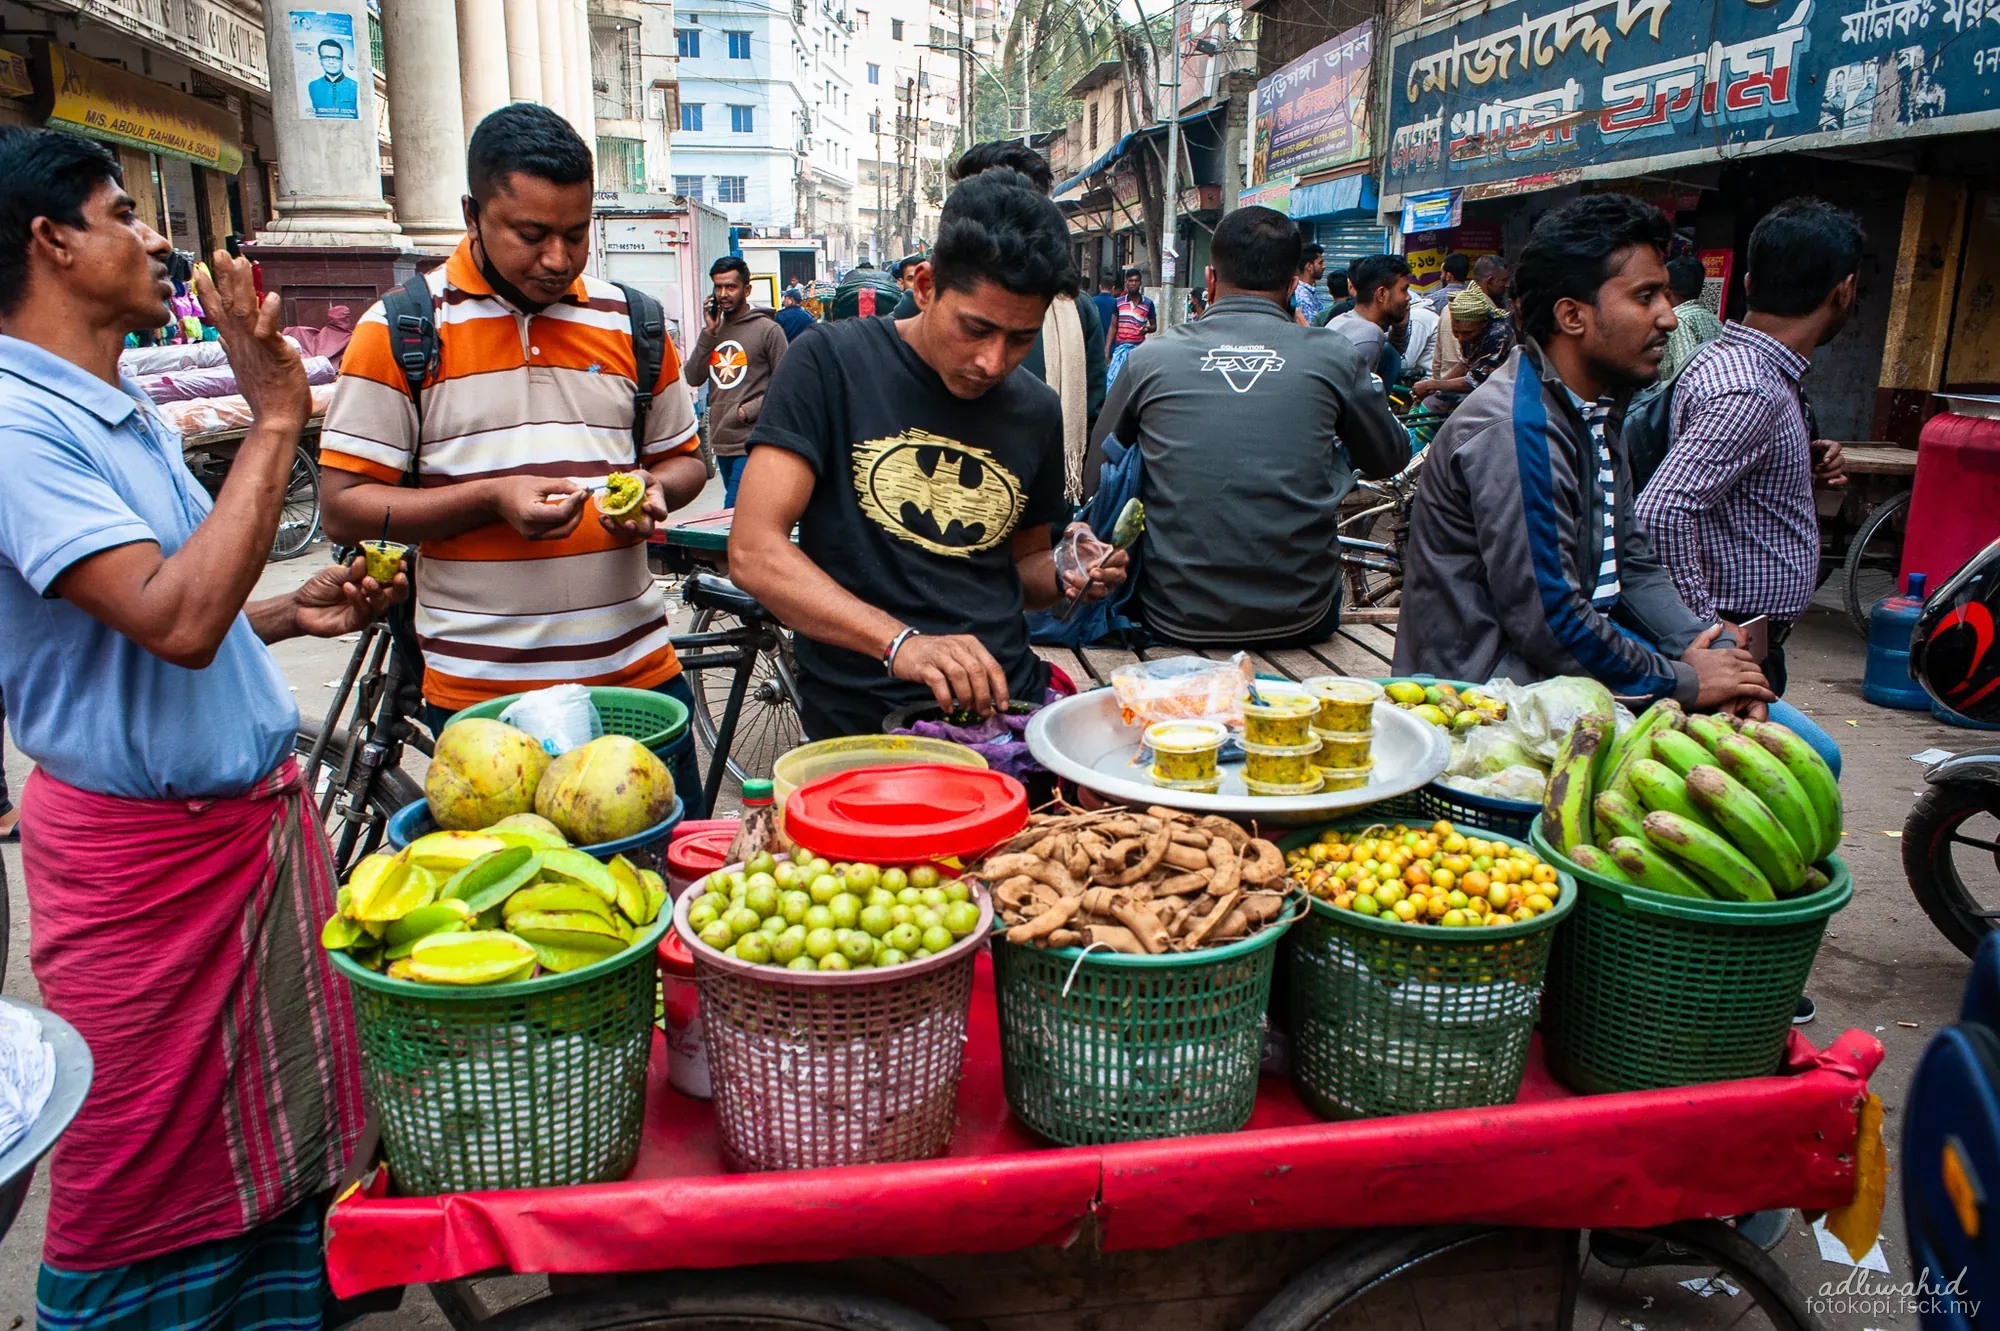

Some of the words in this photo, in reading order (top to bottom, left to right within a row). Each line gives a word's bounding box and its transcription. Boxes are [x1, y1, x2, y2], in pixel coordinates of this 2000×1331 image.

[1323, 31, 1373, 68] ভবন
[85, 109, 107, 128] M/S.
[109, 116, 146, 140] ABDUL
[147, 129, 186, 150] RAHMAN
[187, 139, 196, 151] &
[196, 142, 217, 159] SONS
